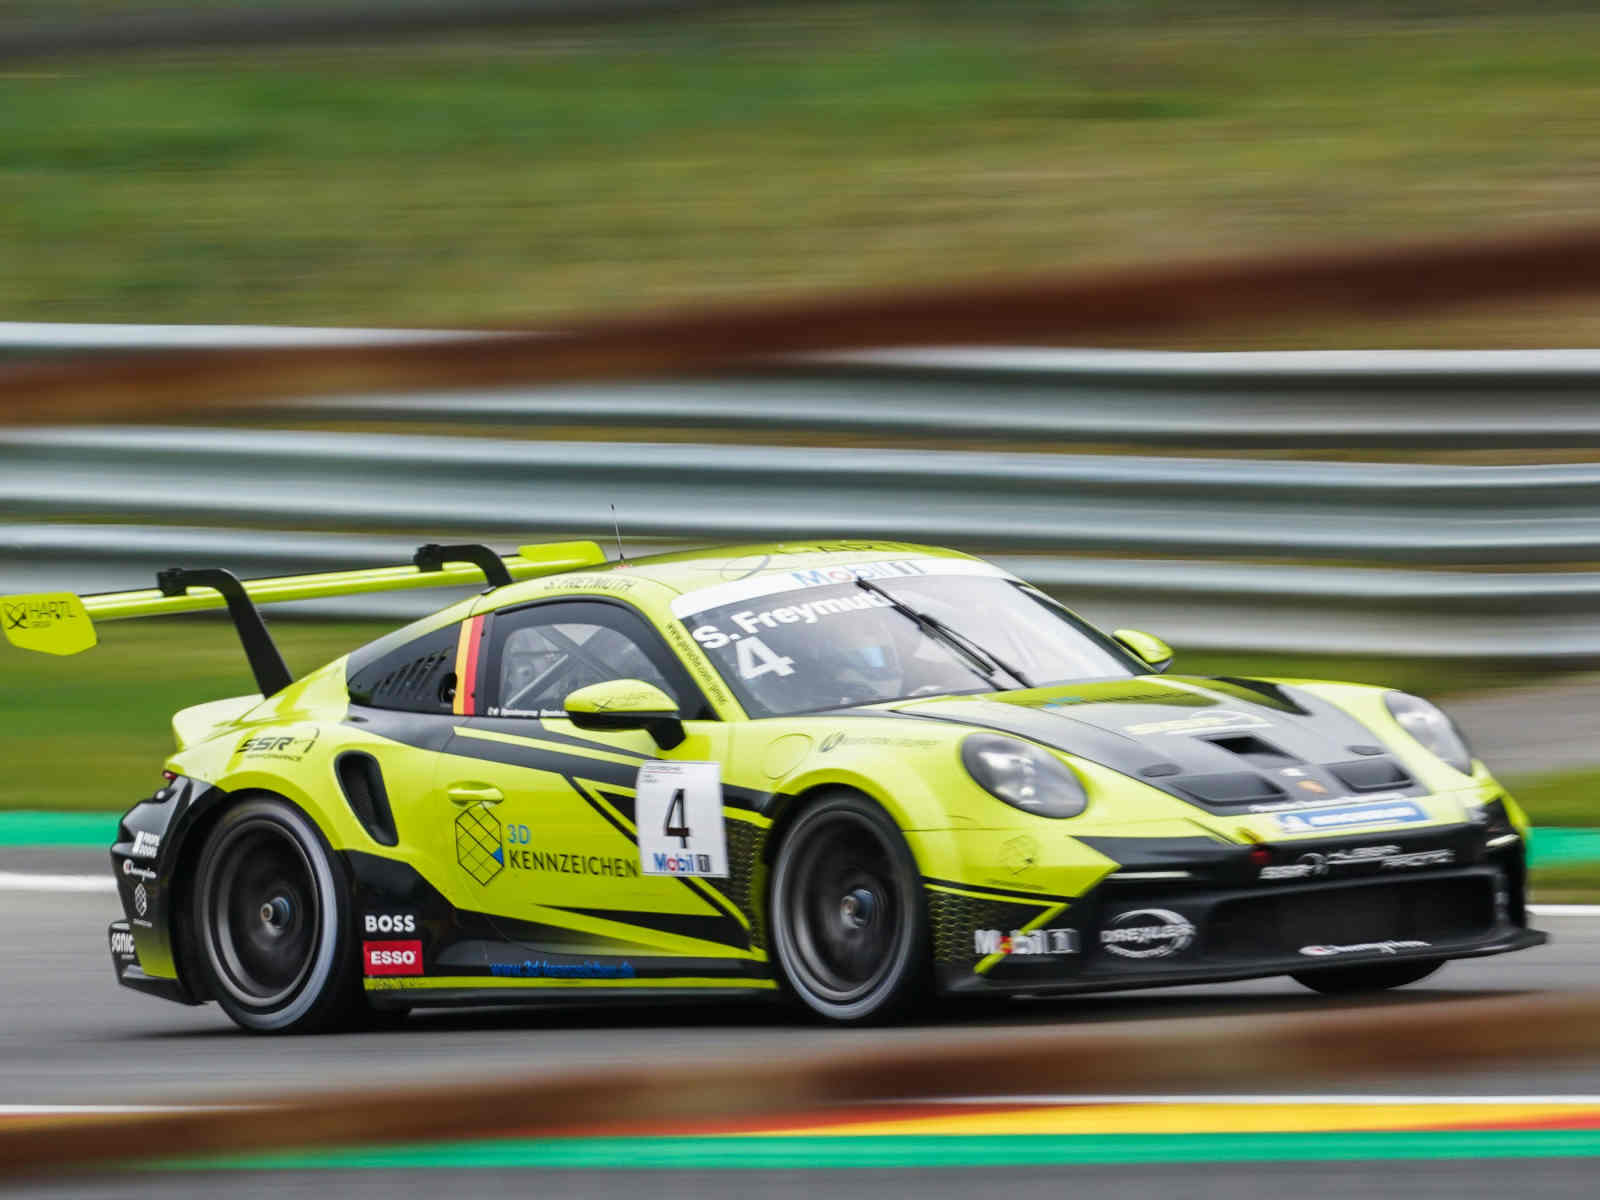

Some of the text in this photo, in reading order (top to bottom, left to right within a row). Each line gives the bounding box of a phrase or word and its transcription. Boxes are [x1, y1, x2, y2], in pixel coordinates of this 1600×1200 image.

[692, 589, 893, 649] S. Freymut
[736, 636, 795, 680] 4
[662, 787, 692, 849] 4
[507, 824, 531, 845] 3D
[509, 849, 638, 878] KENNZEICHEN
[653, 853, 695, 873] Mobil
[364, 914, 416, 933] BOSS
[975, 929, 1076, 954] Mobil 1
[370, 950, 416, 965] ESSO
